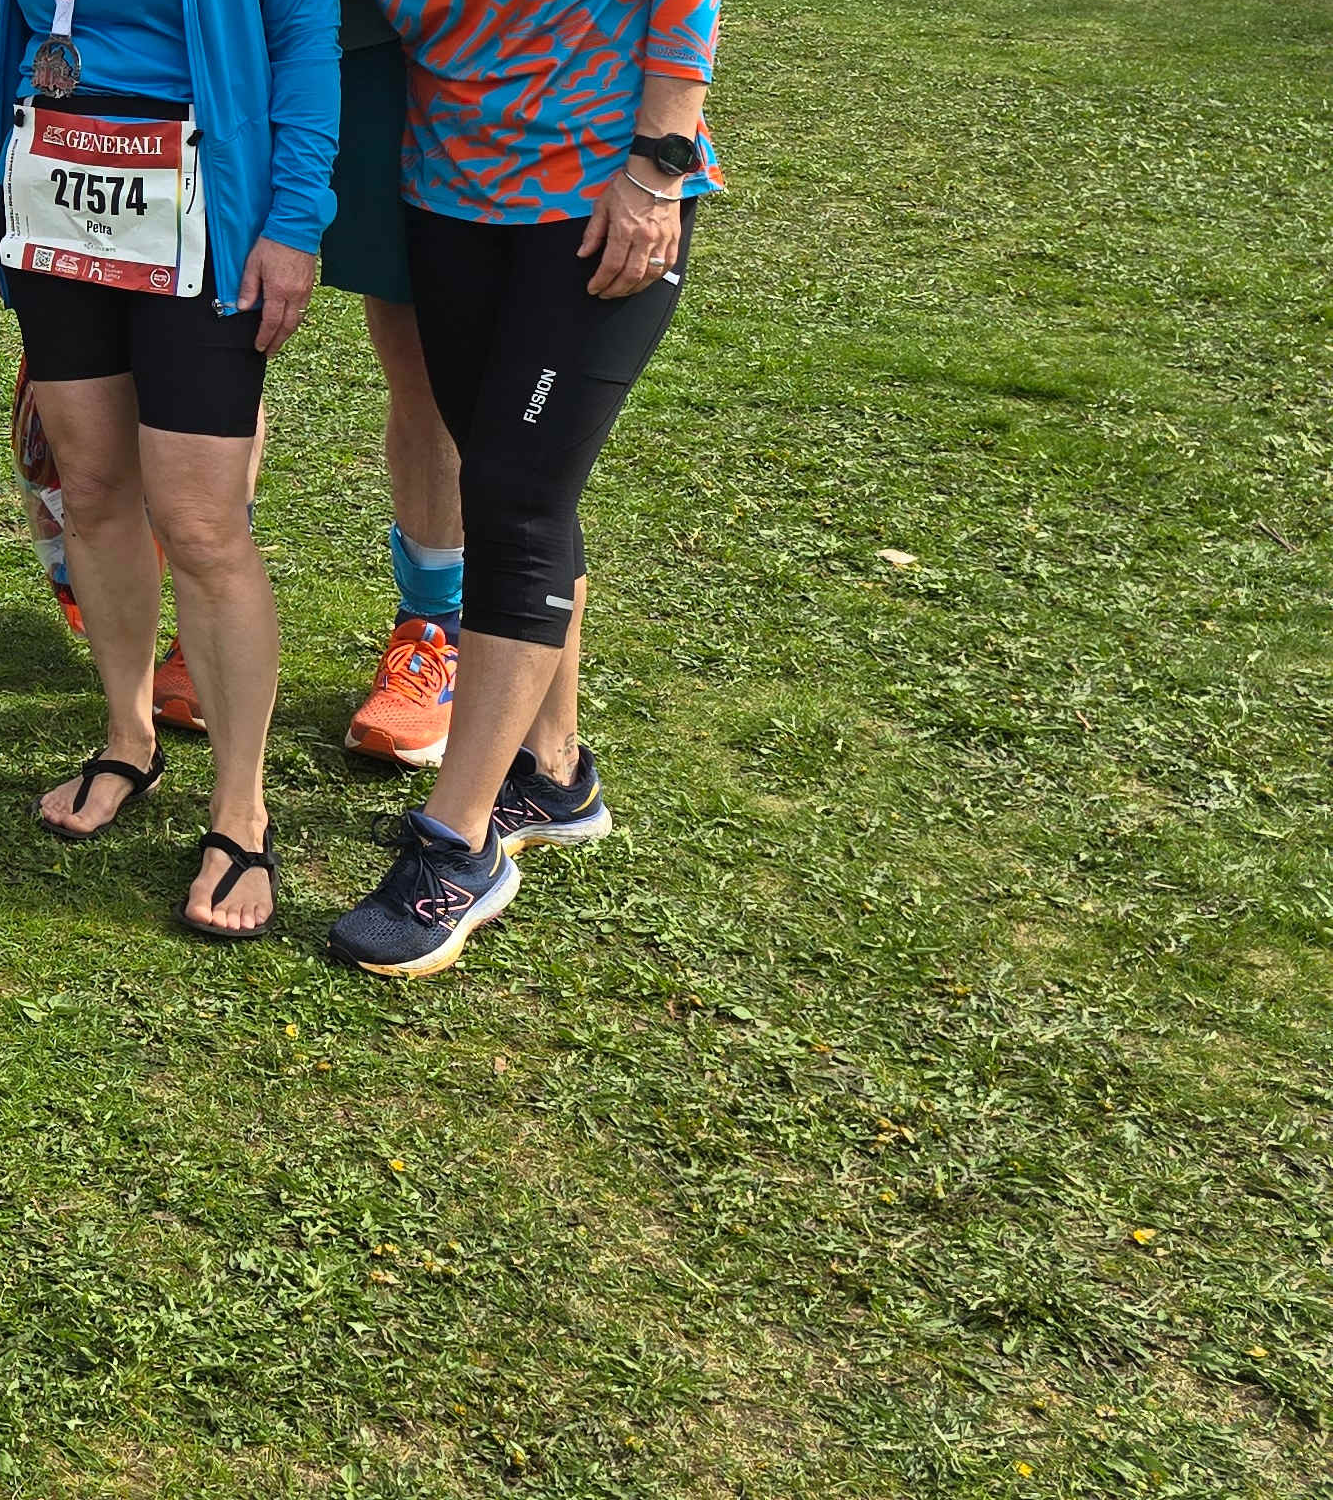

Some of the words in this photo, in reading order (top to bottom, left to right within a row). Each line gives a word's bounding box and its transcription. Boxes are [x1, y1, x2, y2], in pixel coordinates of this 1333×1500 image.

[65, 129, 163, 155] GENERALI
[50, 168, 148, 216] 27574
[185, 177, 191, 190] F
[86, 220, 113, 236] Petra
[523, 368, 557, 424] FUSION
